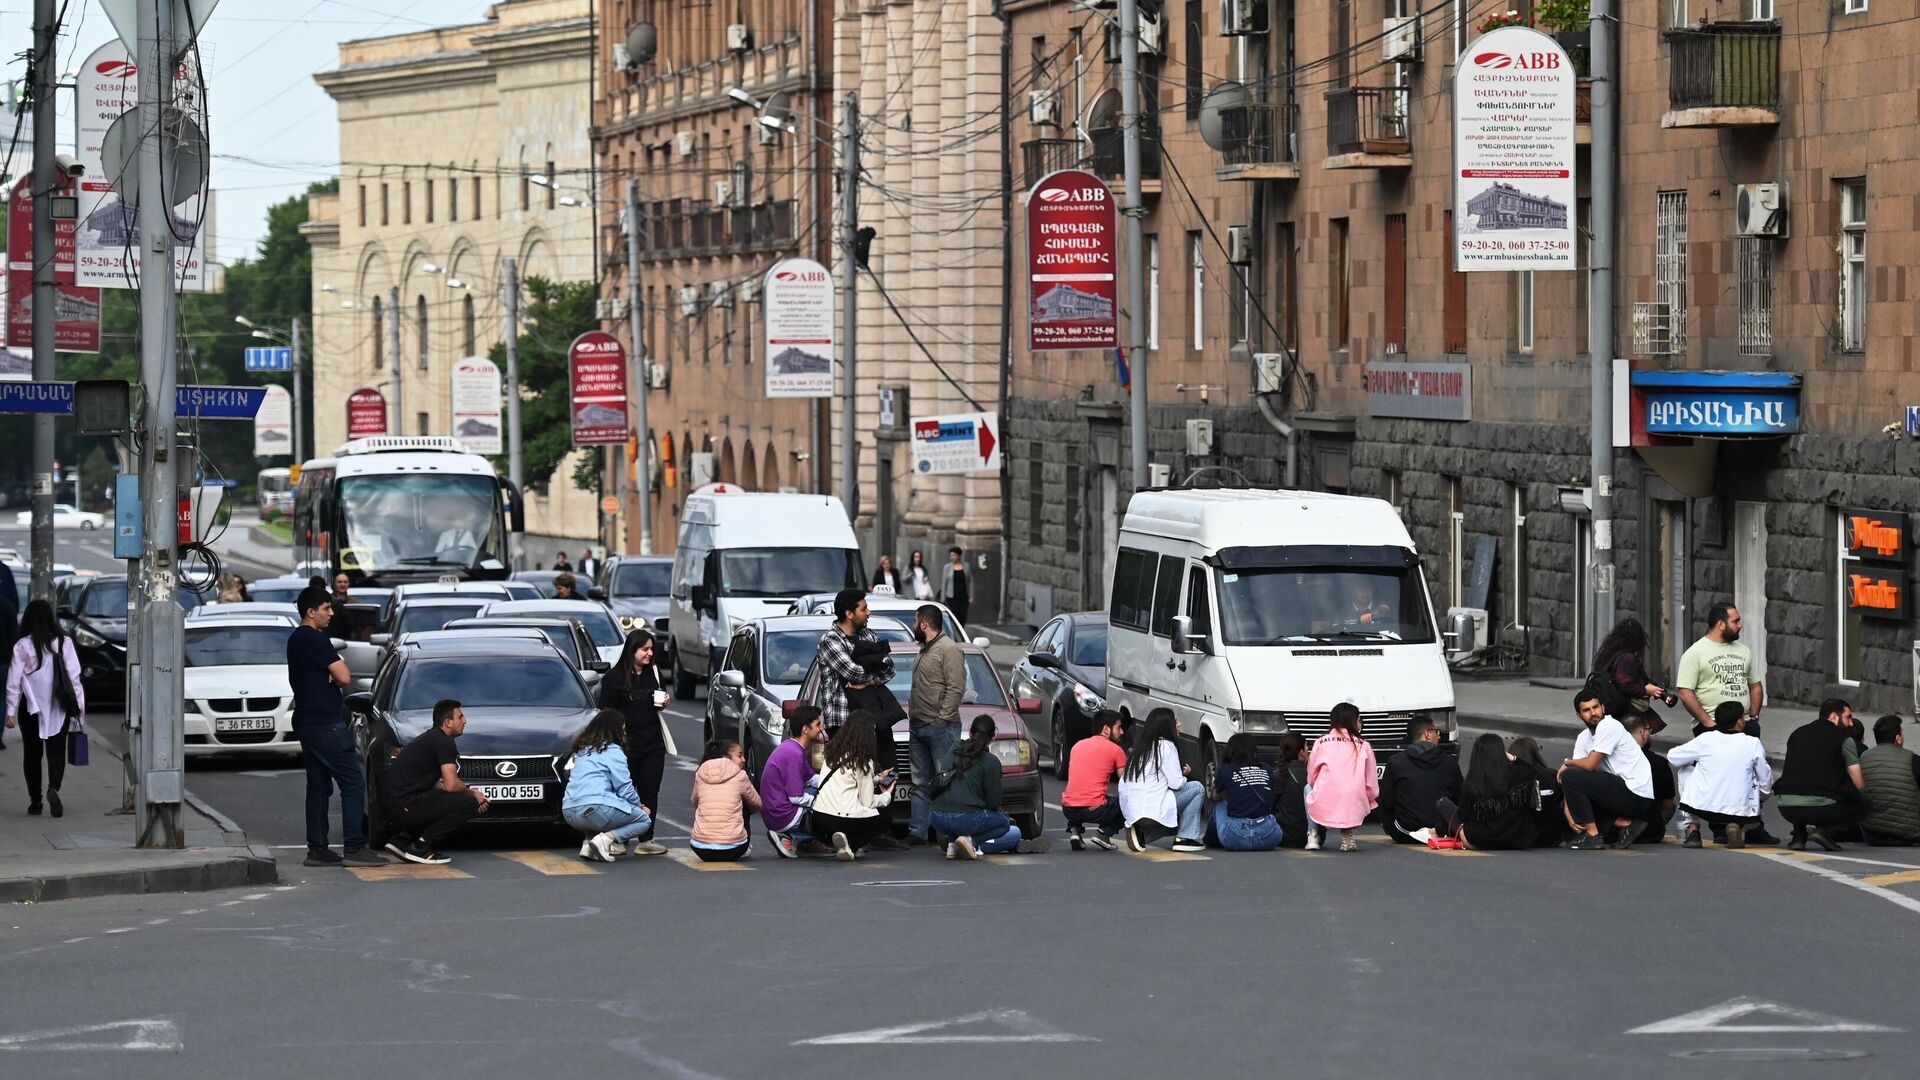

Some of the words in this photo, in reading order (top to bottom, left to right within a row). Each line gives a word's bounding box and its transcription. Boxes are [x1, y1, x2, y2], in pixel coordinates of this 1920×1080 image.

[1514, 53, 1560, 69] ABB
[1070, 188, 1104, 201] ABB
[1041, 223, 1103, 233] ԱՊԱԳԱՅԻ
[1045, 239, 1100, 248] ՀՈՒՍԱԼԻ
[1462, 241, 1506, 250] 59-20-20,
[1509, 241, 1525, 250] 060
[1529, 241, 1569, 250] 37-25-00
[1037, 253, 1109, 263] ՃԱՆԱՊԱՐՀ
[800, 272, 825, 281] ABB
[1650, 401, 1786, 427] ԲՐԻՏԱՆԻԱ
[1712, 662, 1745, 674] Original
[228, 720, 238, 729] 36
[241, 719, 253, 728] FR
[256, 719, 271, 728] 815
[485, 787, 498, 798] 50
[501, 786, 517, 798] OQ
[520, 786, 540, 797] 555
